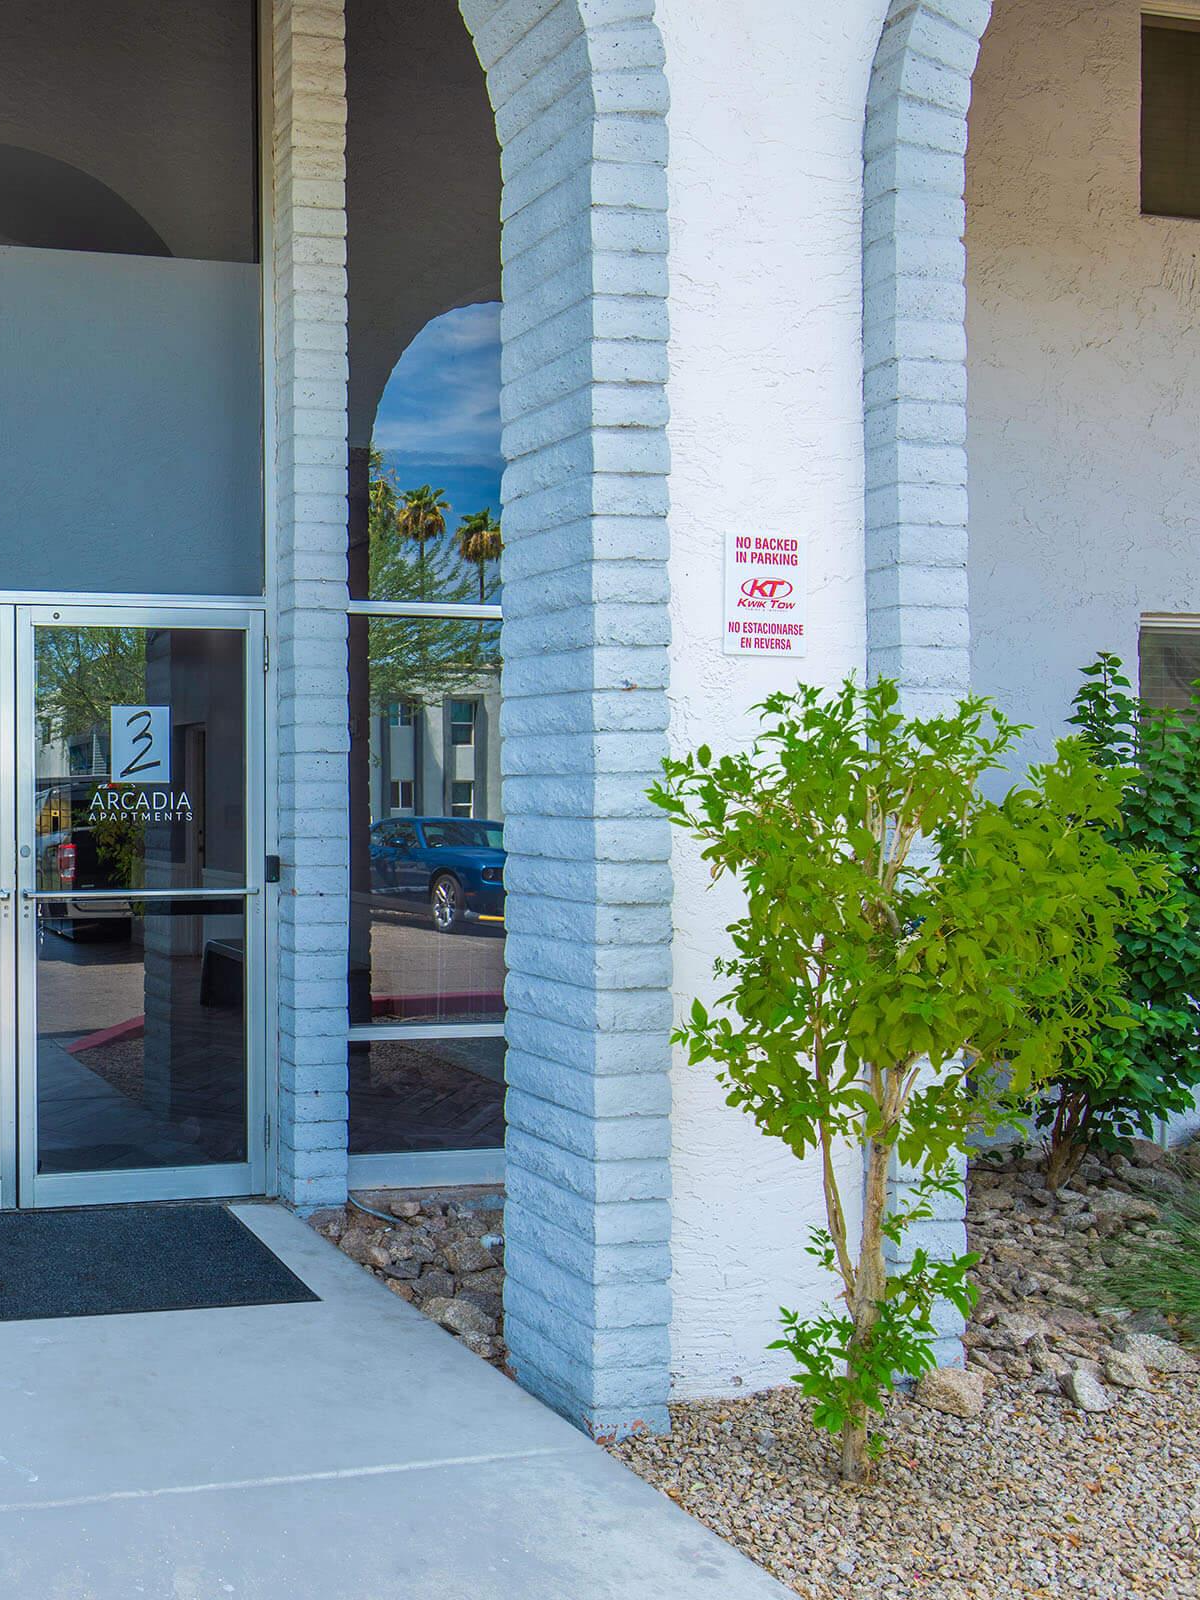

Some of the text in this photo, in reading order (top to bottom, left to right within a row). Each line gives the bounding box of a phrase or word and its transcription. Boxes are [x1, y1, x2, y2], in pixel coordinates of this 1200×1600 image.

[736, 536, 798, 552] NO BACKED
[736, 551, 798, 566] IN PARKING
[749, 579, 785, 597] KT
[728, 621, 804, 636] NO ESTACIONARSE
[740, 637, 792, 650] EN REVERSA
[90, 791, 191, 810] ARCADIA
[88, 812, 193, 822] APARTMENTS
